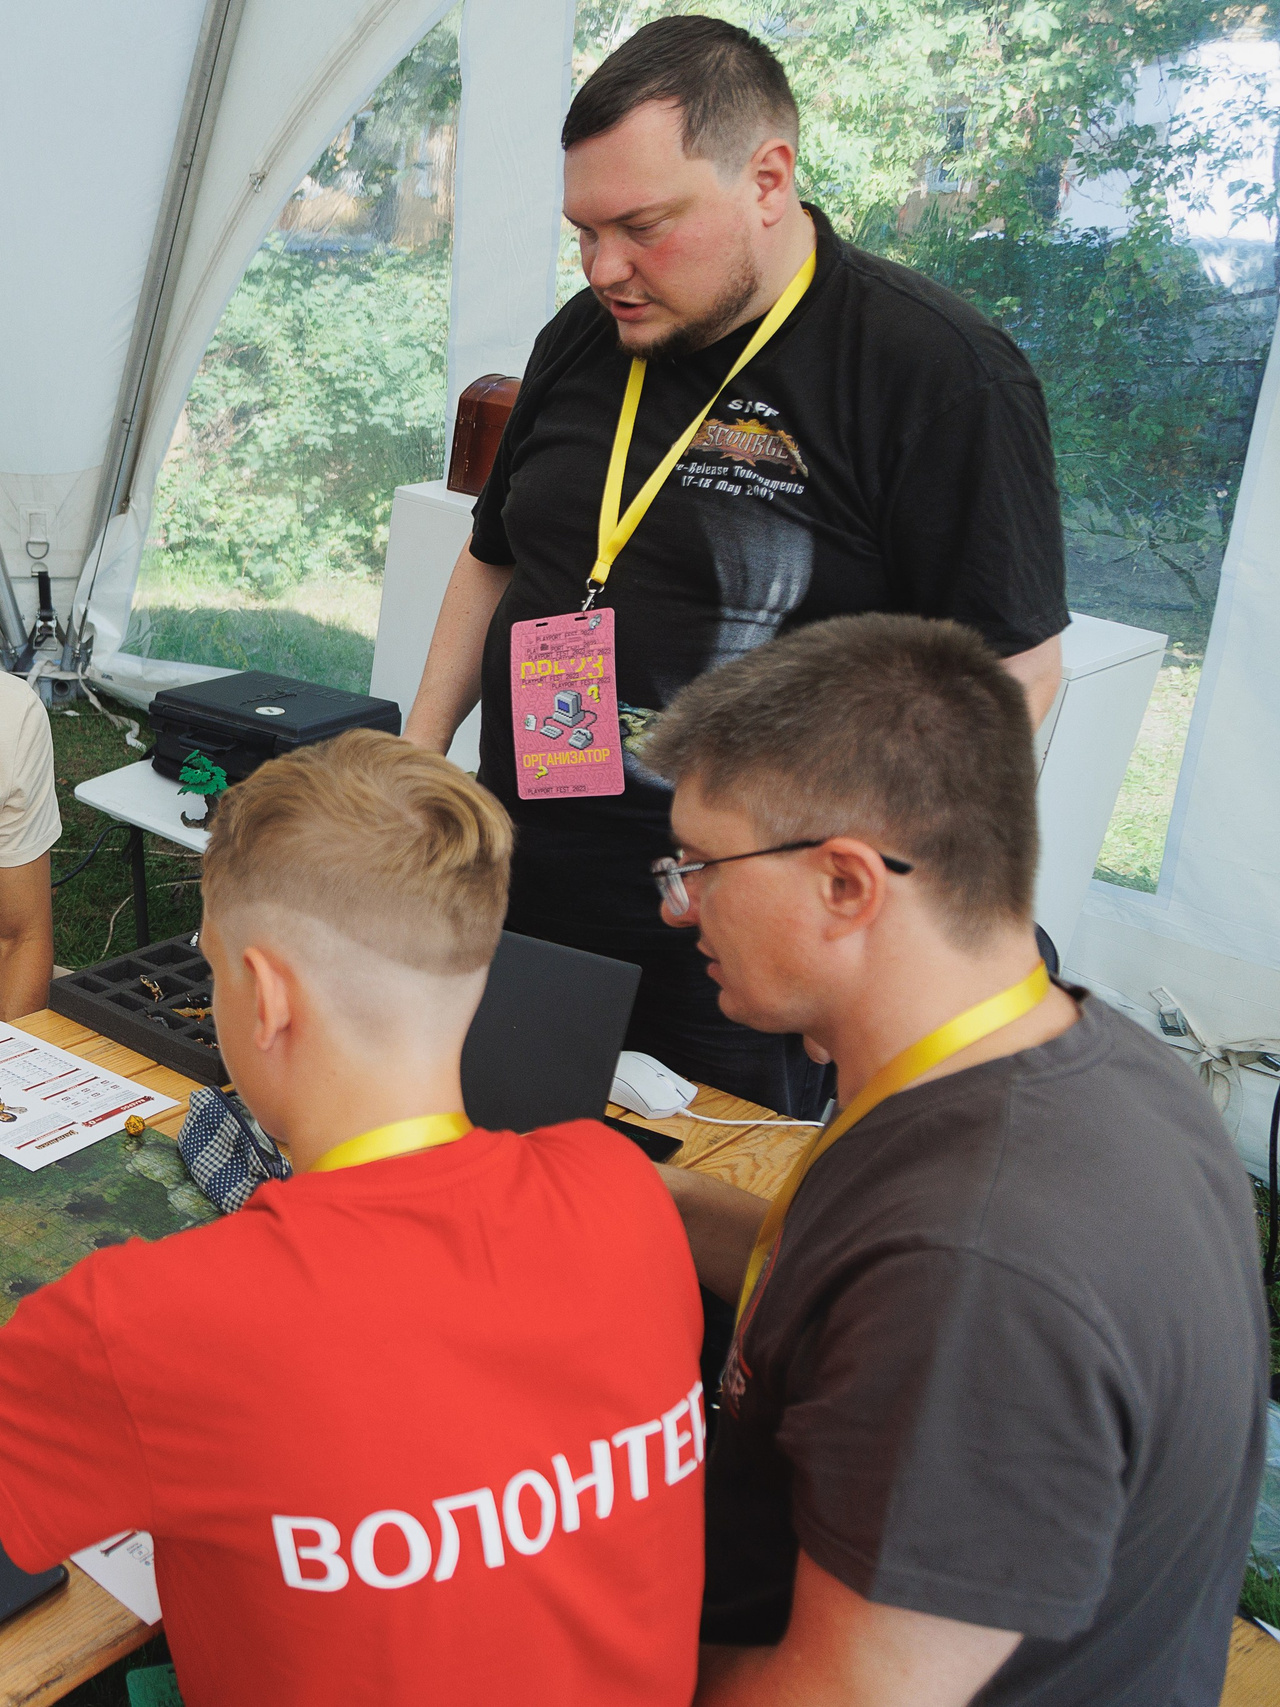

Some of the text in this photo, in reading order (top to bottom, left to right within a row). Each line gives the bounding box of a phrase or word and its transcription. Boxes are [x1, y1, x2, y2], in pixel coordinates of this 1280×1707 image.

[703, 425, 790, 460] SCOURGE
[682, 475, 713, 489] 17-18
[716, 478, 742, 496] May
[523, 748, 611, 768] ОРГАНИЗАТОР
[527, 787, 554, 795] PLAYPORT
